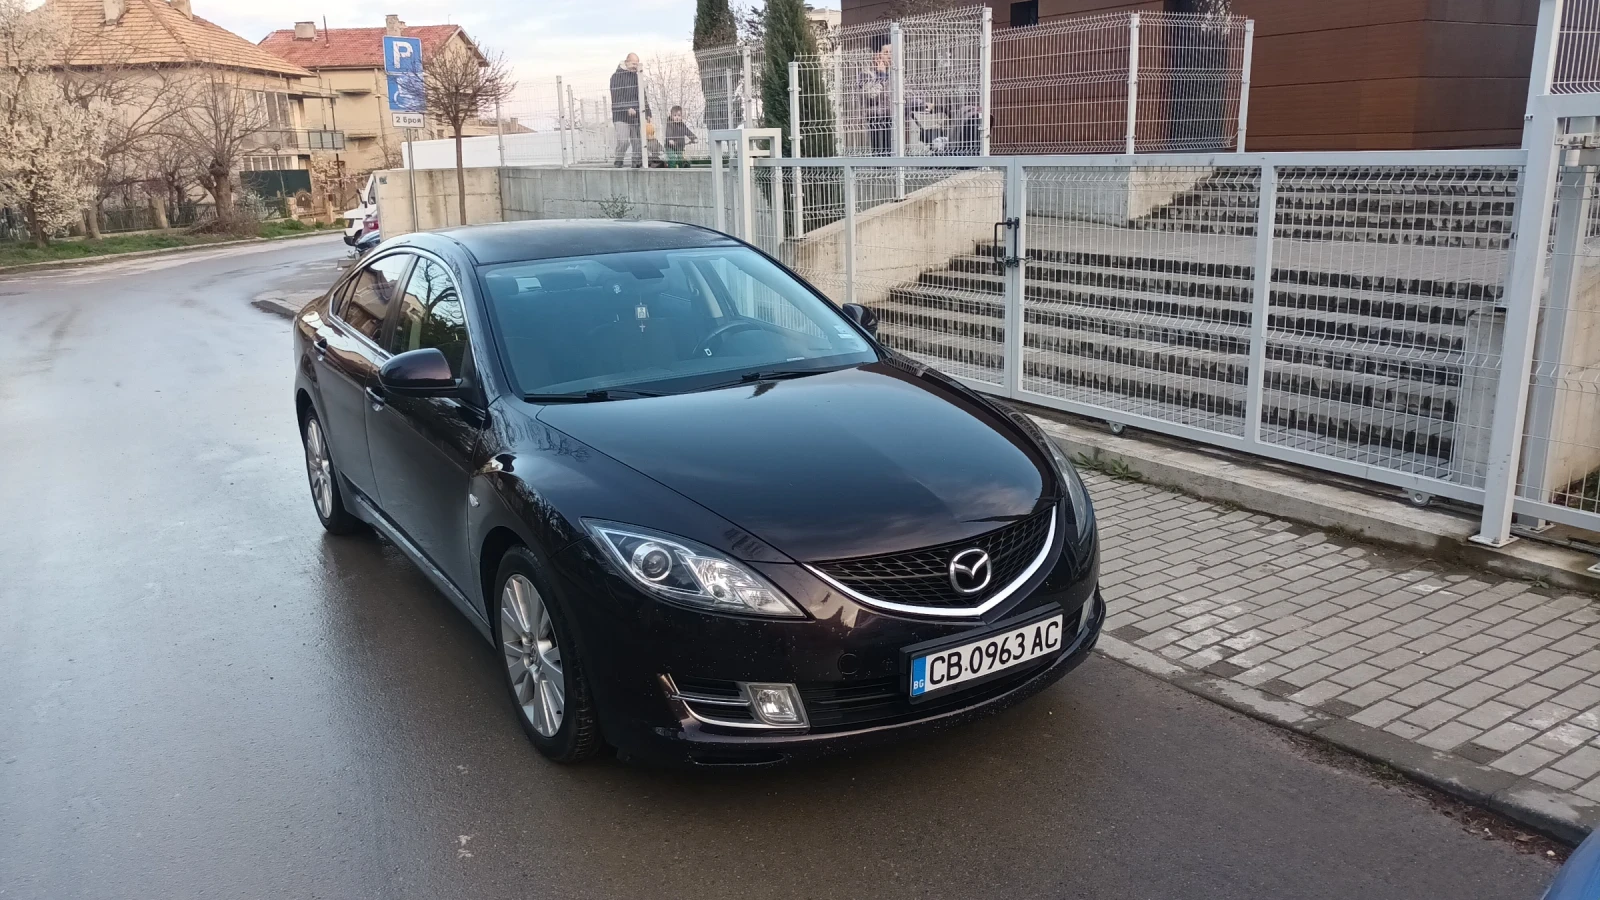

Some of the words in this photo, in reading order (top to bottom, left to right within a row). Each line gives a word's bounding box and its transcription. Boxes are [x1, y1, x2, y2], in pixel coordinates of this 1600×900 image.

[393, 41, 413, 69] P
[929, 651, 963, 685] CB
[969, 632, 1026, 674] 0963
[1030, 621, 1059, 655] AC
[913, 679, 925, 690] BG
